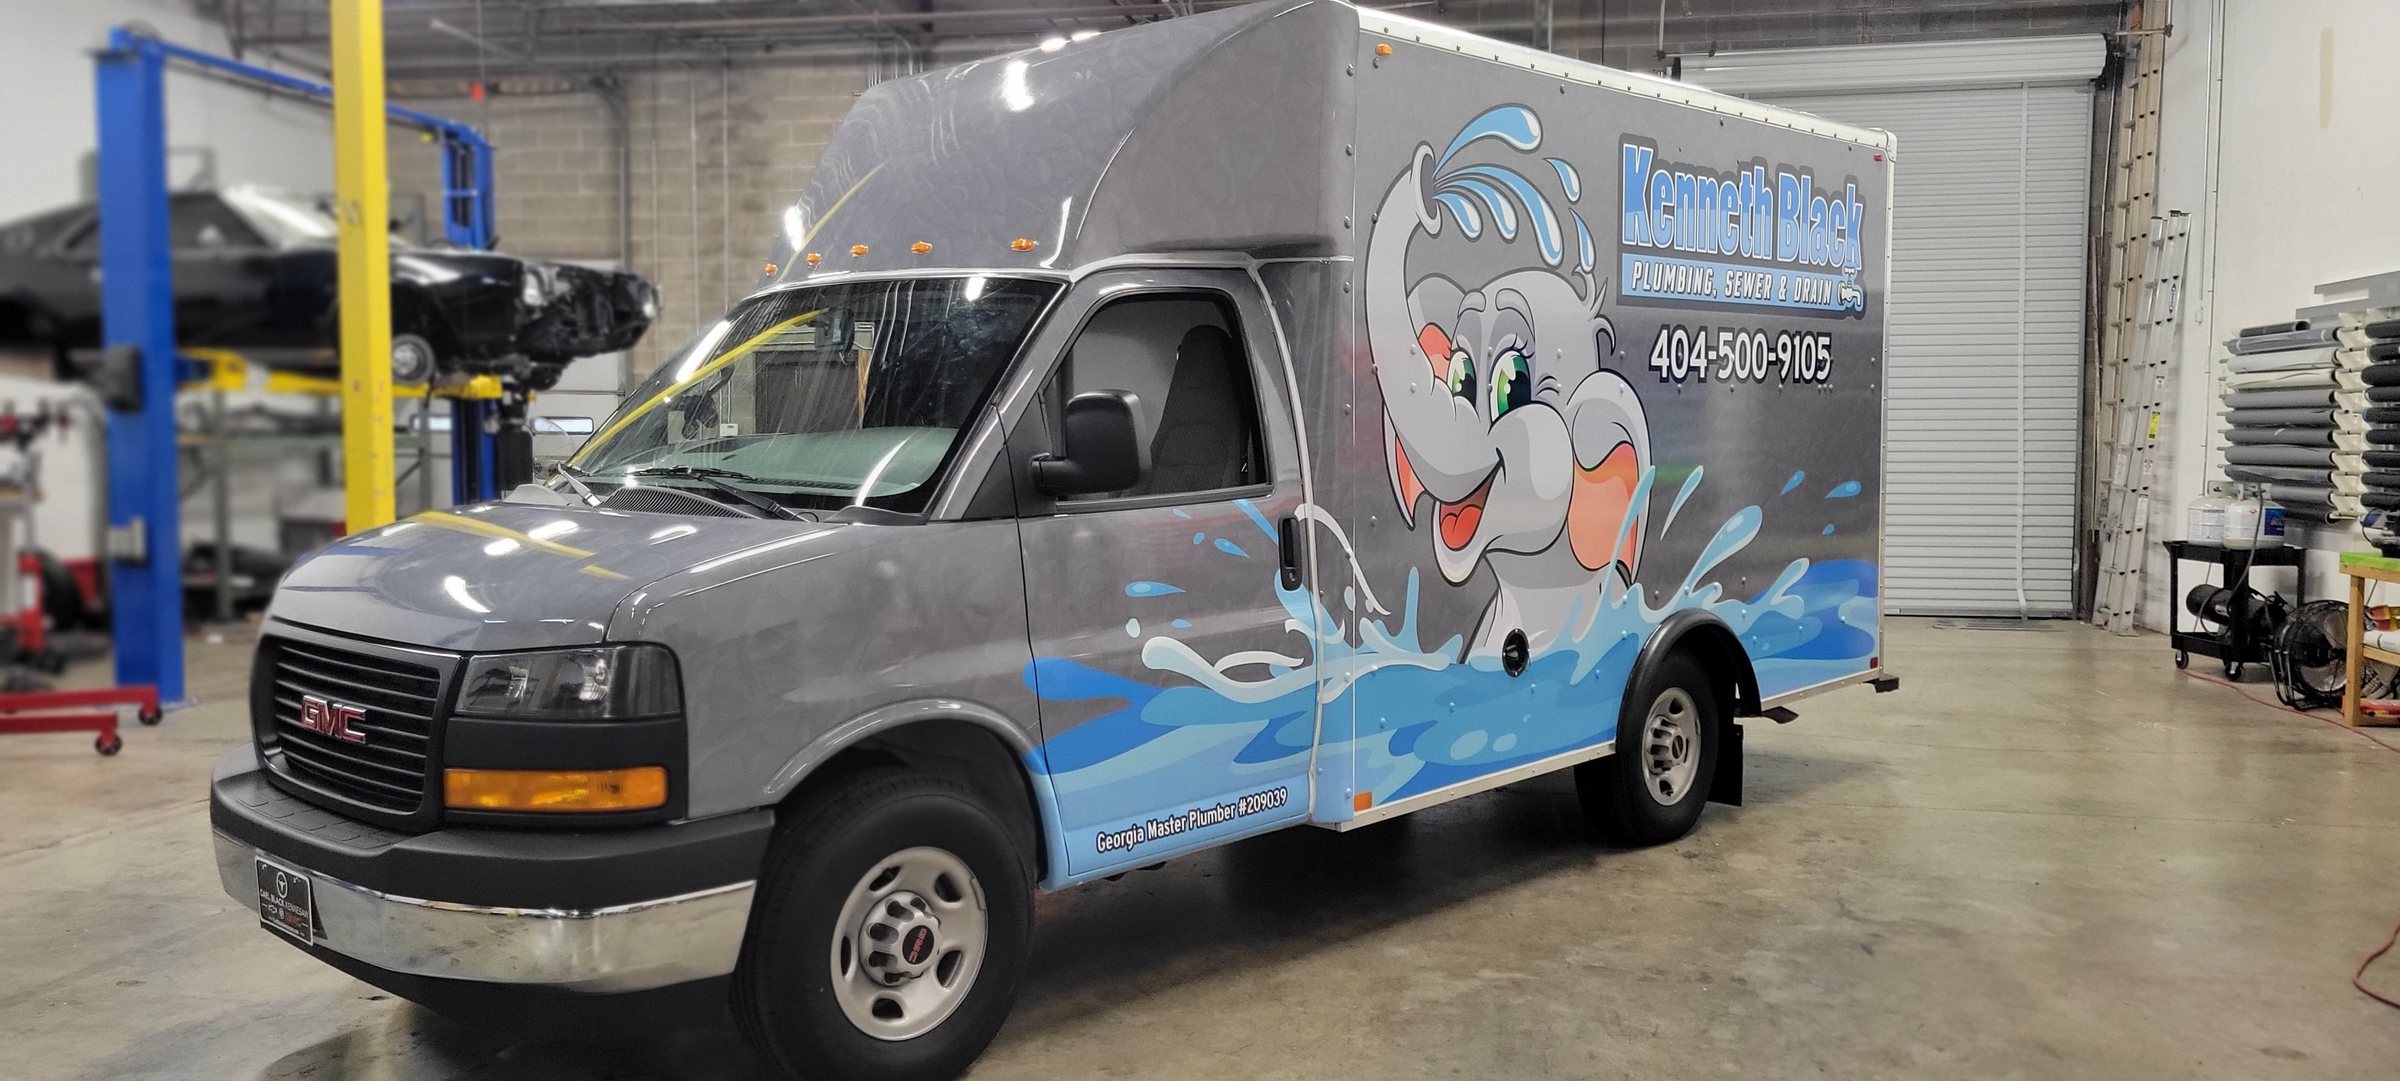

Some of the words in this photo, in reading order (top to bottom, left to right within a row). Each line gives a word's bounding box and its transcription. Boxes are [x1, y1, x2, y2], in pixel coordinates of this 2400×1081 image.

[1623, 143, 1773, 260] Kenneth
[1777, 171, 1863, 270] Black
[1632, 260, 1717, 298] PLUMBING,
[1725, 270, 1772, 300] SEWER
[1779, 275, 1787, 301] &
[1794, 277, 1833, 304] DRAIN
[1650, 328, 1831, 382] 404-500-9105
[302, 695, 367, 744] GMC
[1097, 826, 1145, 852] Georgia
[1147, 816, 1186, 840] Master
[1188, 802, 1236, 832] Plumber
[1238, 787, 1287, 816] #209039
[908, 927, 928, 963] GMC
